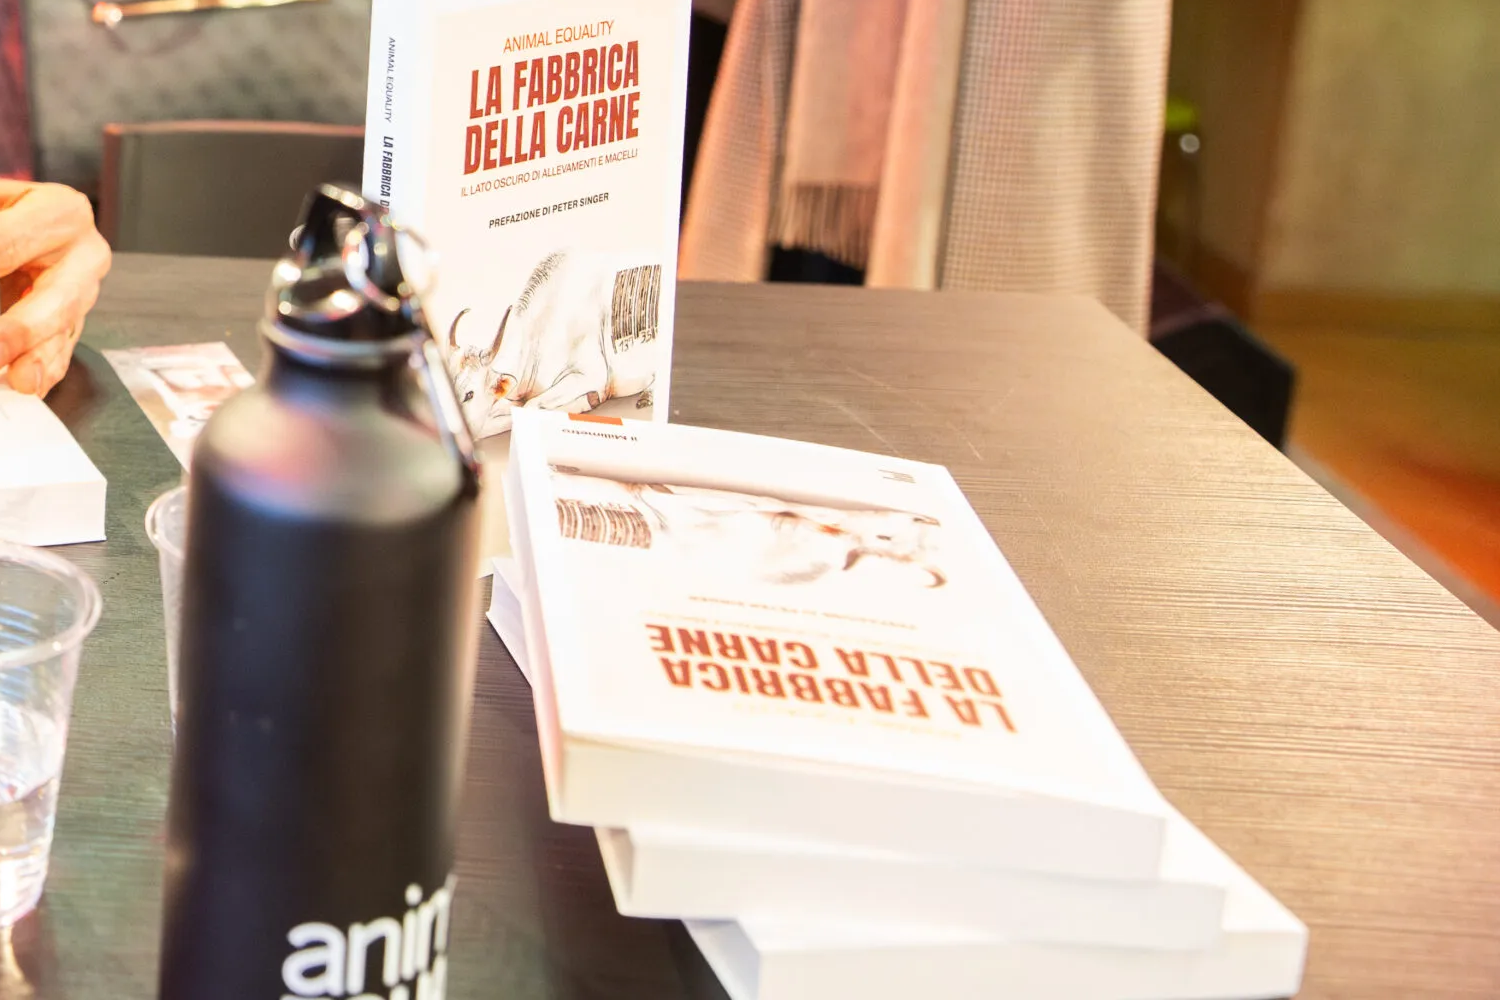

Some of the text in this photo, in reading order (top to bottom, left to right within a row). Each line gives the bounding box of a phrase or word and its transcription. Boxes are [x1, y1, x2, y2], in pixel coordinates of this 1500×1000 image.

[502, 19, 615, 53] ANIMAL EQUALITY
[384, 36, 396, 123] ANIMAL EQUALITY
[469, 40, 639, 119] LA FABBRICA
[383, 135, 394, 148] LA
[463, 92, 641, 175] DELLA CARNE
[380, 150, 393, 197] FABBRICA
[460, 148, 638, 197] IL LATO OSCURO DI ALLEVAMENTI E MACELLI
[488, 192, 609, 229] PREFAZIONE DI PETER SINGER
[645, 623, 820, 670] CARNE
[659, 656, 930, 719] FABBRICA
[832, 646, 1003, 698] DELLA
[943, 694, 1018, 734] LA
